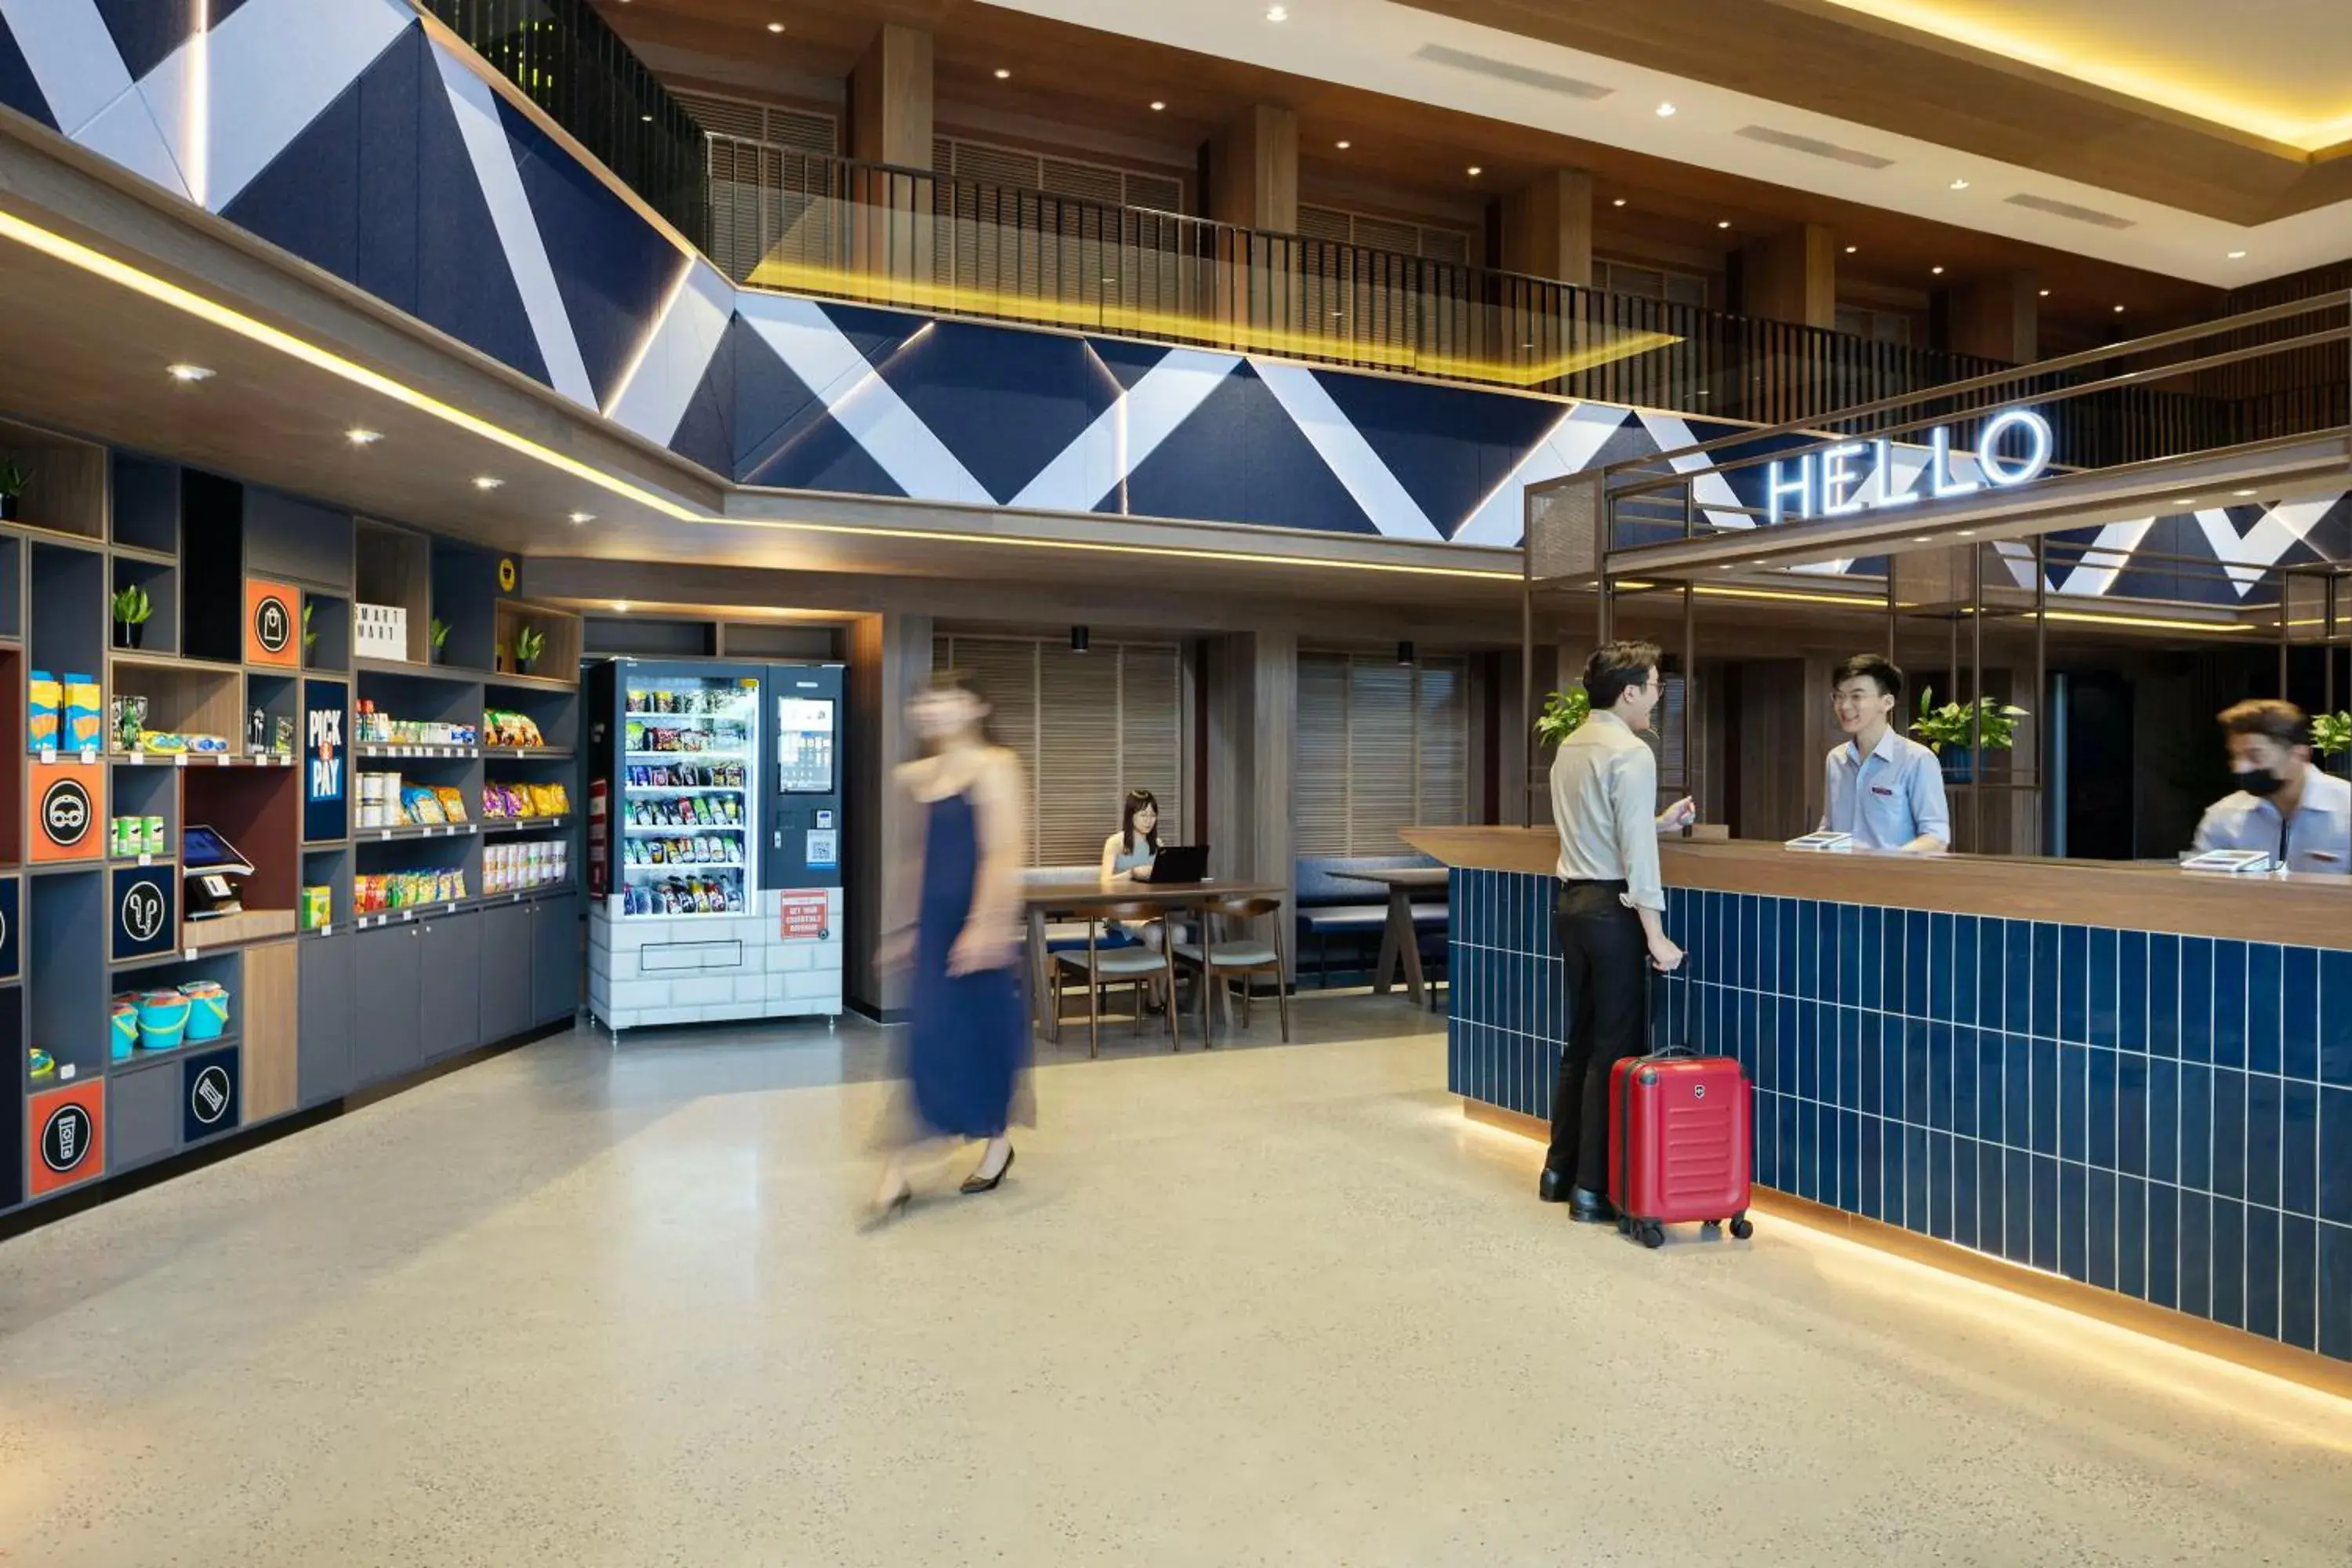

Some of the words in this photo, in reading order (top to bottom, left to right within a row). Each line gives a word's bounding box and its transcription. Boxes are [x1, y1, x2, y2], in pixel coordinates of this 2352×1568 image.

[1769, 411, 2053, 524] HELLO
[310, 710, 341, 747] PICK
[314, 758, 339, 797] PAY
